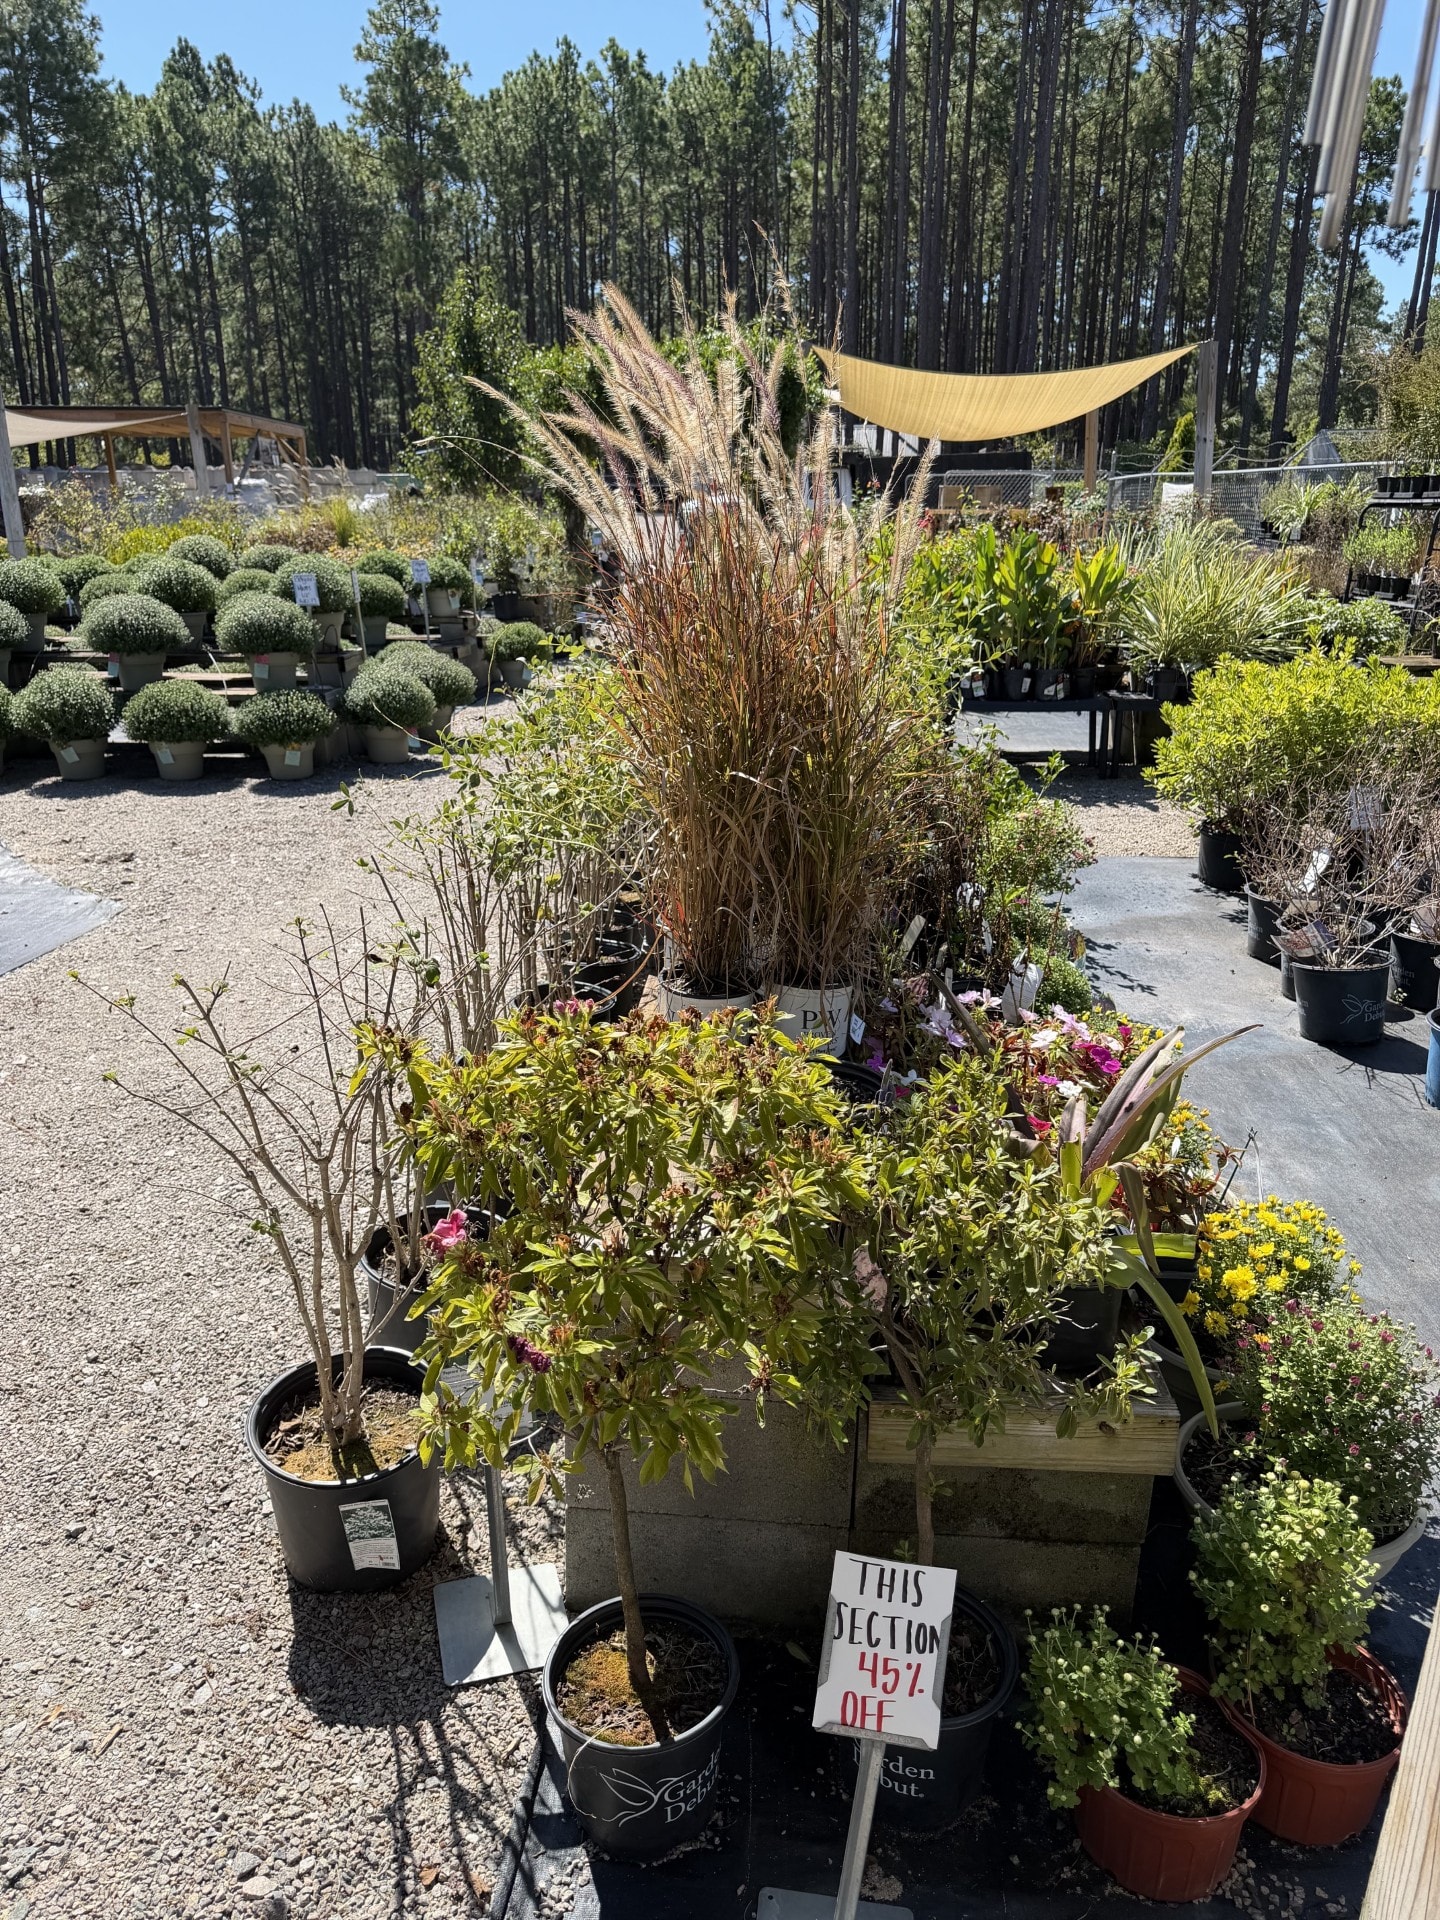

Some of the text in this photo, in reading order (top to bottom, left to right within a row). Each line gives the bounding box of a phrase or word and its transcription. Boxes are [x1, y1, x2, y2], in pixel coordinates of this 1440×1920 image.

[849, 1558, 926, 1607] THIS
[833, 1601, 941, 1655] SECTION
[858, 1651, 925, 1698] 45%
[840, 1690, 897, 1733] OFF
[880, 1755, 936, 1779] rden
[880, 1768, 920, 1797] but
